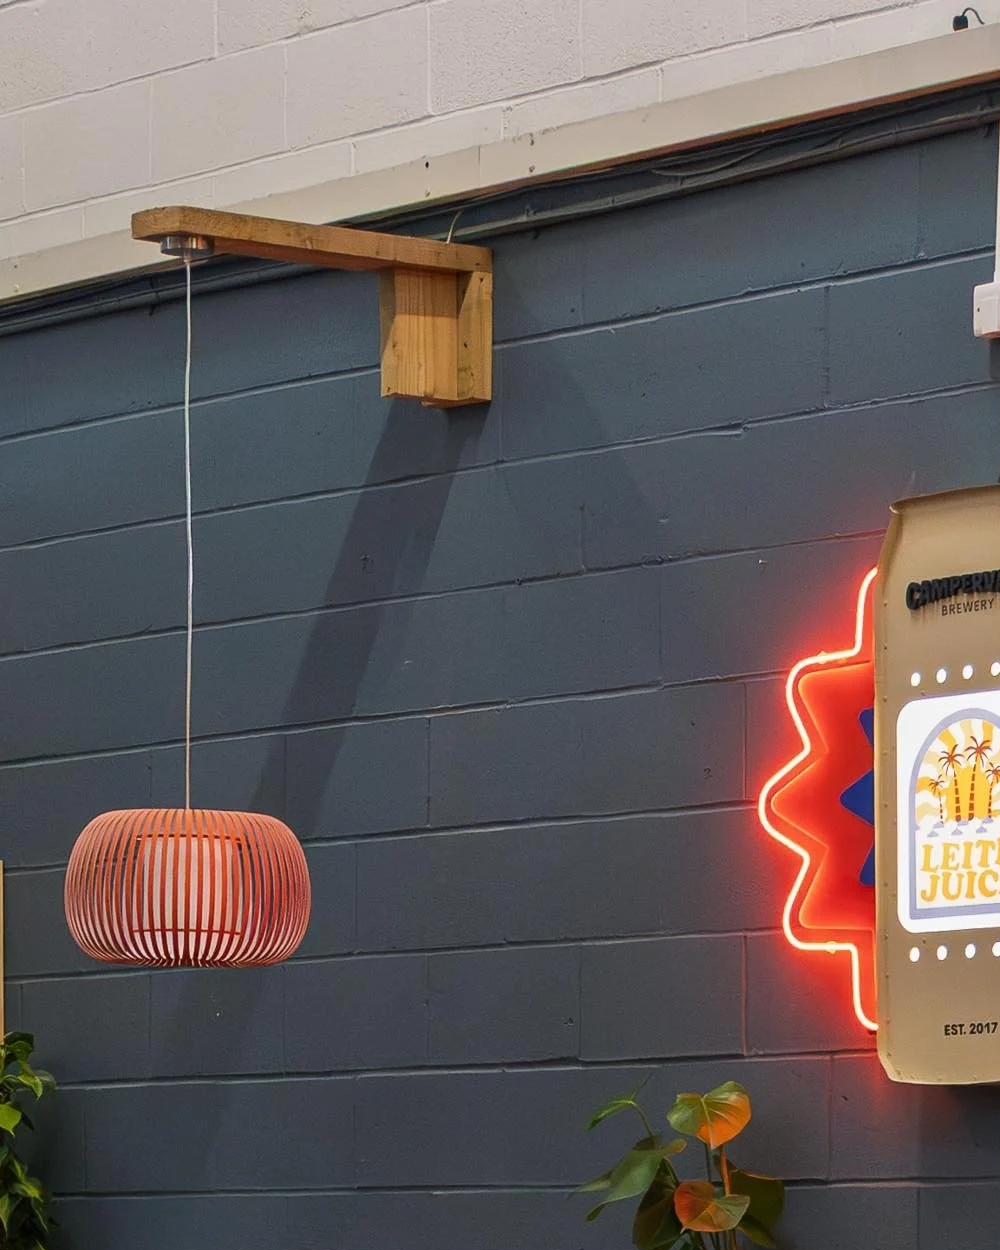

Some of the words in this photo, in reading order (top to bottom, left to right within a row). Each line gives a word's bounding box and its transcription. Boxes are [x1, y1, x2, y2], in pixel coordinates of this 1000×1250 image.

[941, 598, 994, 616] BREWERY
[944, 1023, 966, 1036] EST.
[969, 1022, 998, 1035] 2017
